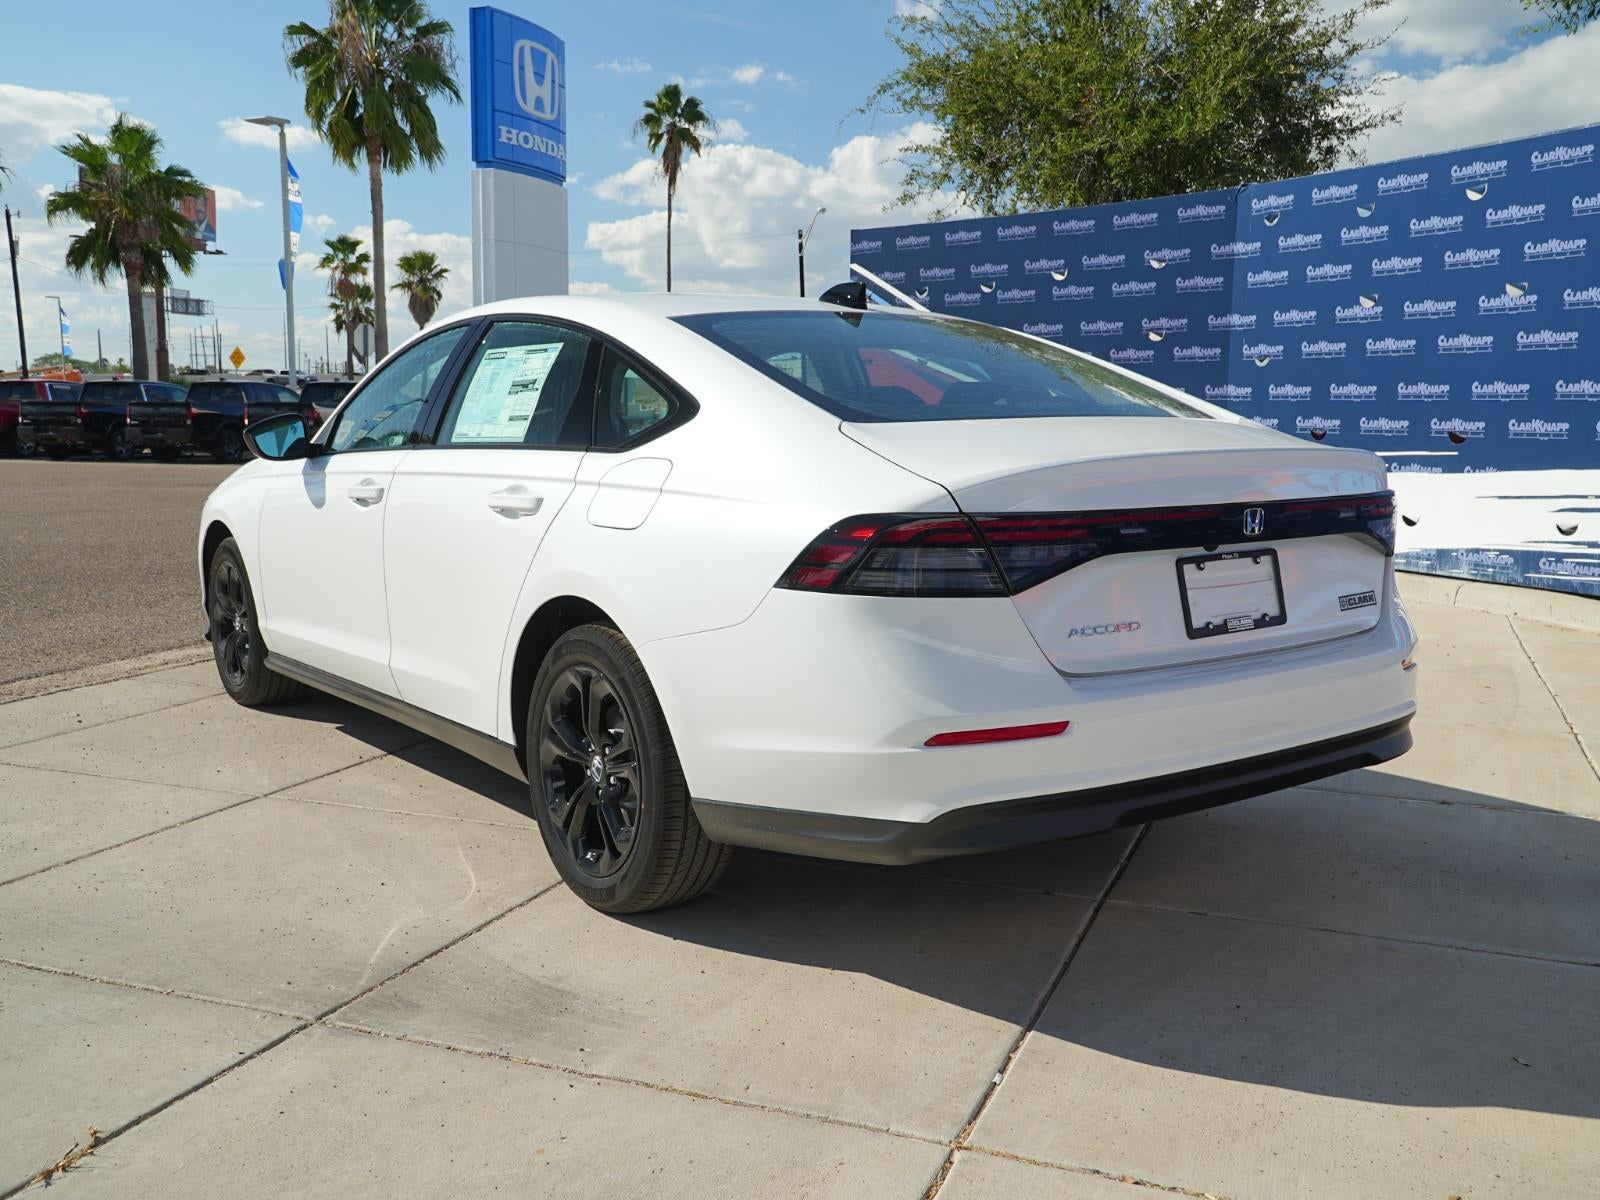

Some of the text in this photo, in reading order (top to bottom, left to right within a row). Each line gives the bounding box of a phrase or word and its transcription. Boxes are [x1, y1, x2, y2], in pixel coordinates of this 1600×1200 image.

[498, 125, 566, 160] HONDA
[1348, 594, 1375, 606] CLARK
[1067, 621, 1141, 639] ACCORD
